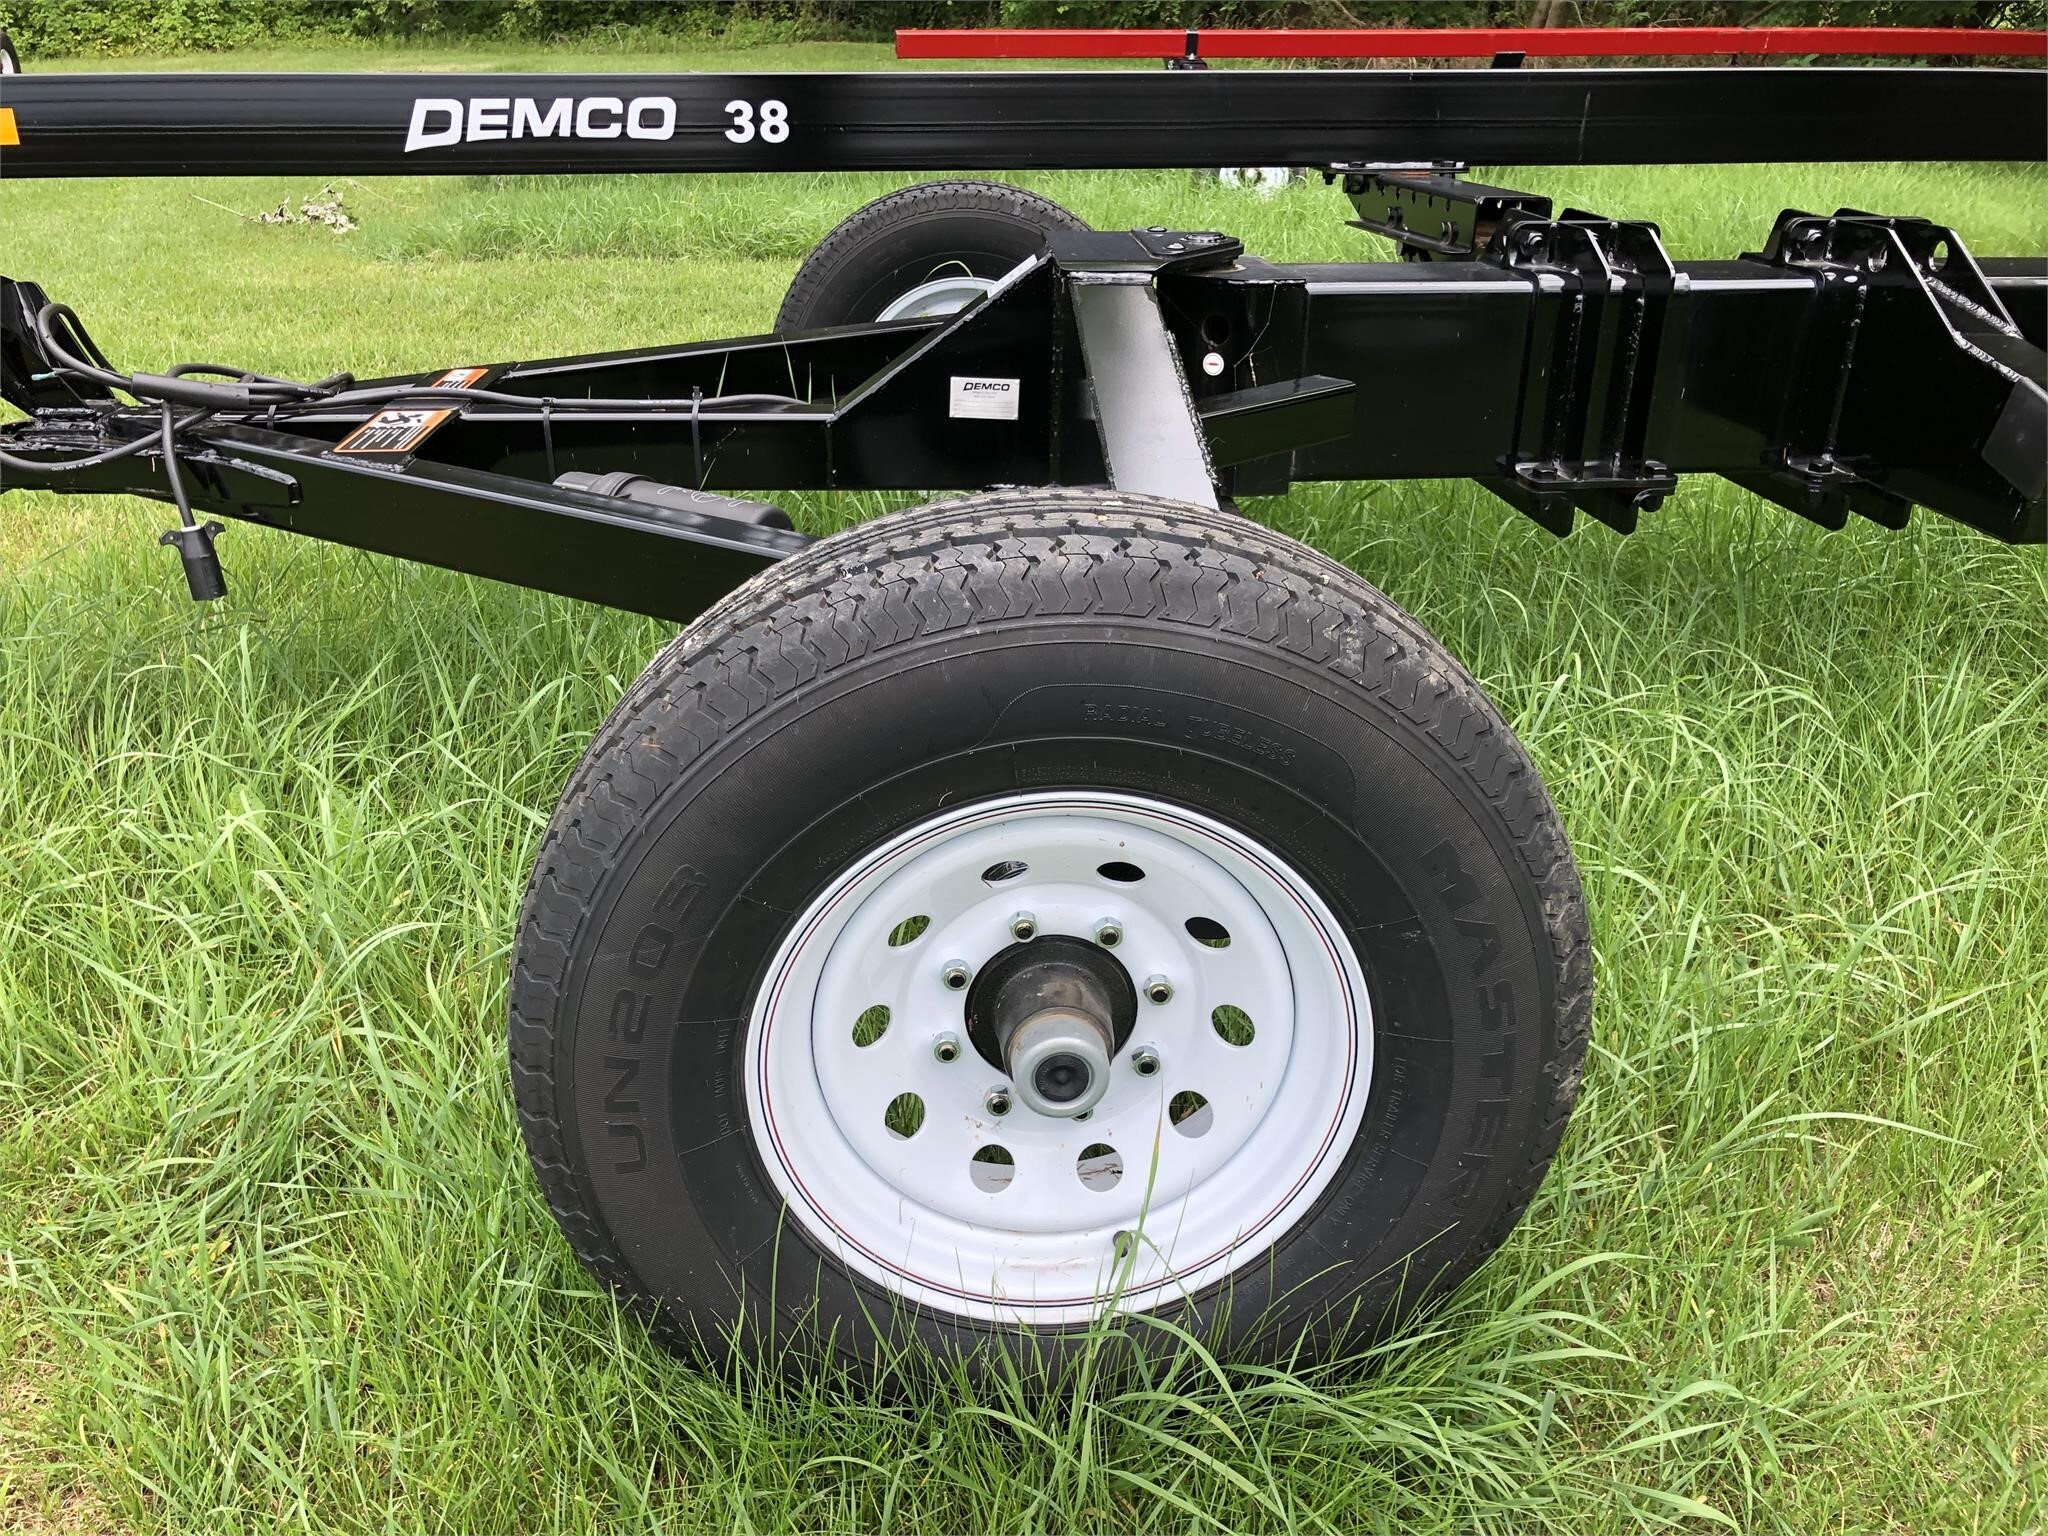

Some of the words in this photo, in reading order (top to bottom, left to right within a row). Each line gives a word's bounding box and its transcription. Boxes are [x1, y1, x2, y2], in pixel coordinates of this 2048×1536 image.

[405, 97, 676, 152] DEMCO
[725, 100, 790, 143] 38
[963, 382, 1011, 391] DEMCO
[1082, 703, 1168, 728] RADIAL
[1183, 714, 1297, 767] TUBELESS
[604, 864, 709, 1174] UN203
